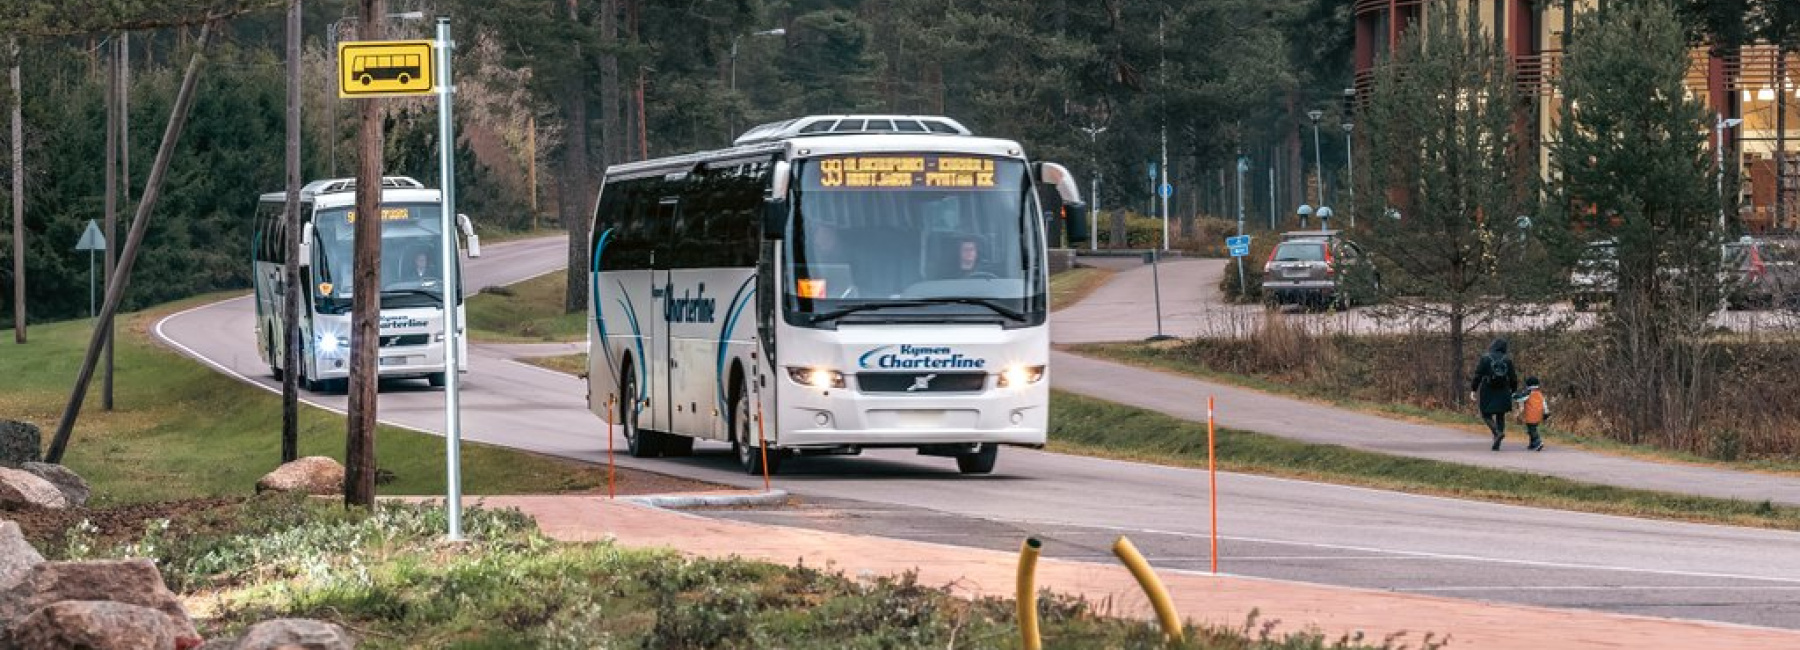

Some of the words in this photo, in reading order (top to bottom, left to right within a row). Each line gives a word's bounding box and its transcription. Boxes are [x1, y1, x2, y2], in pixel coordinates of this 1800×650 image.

[820, 158, 843, 187] 99
[664, 282, 716, 324] Charterline
[900, 344, 951, 356] Kymen
[878, 354, 985, 368] Charterline
